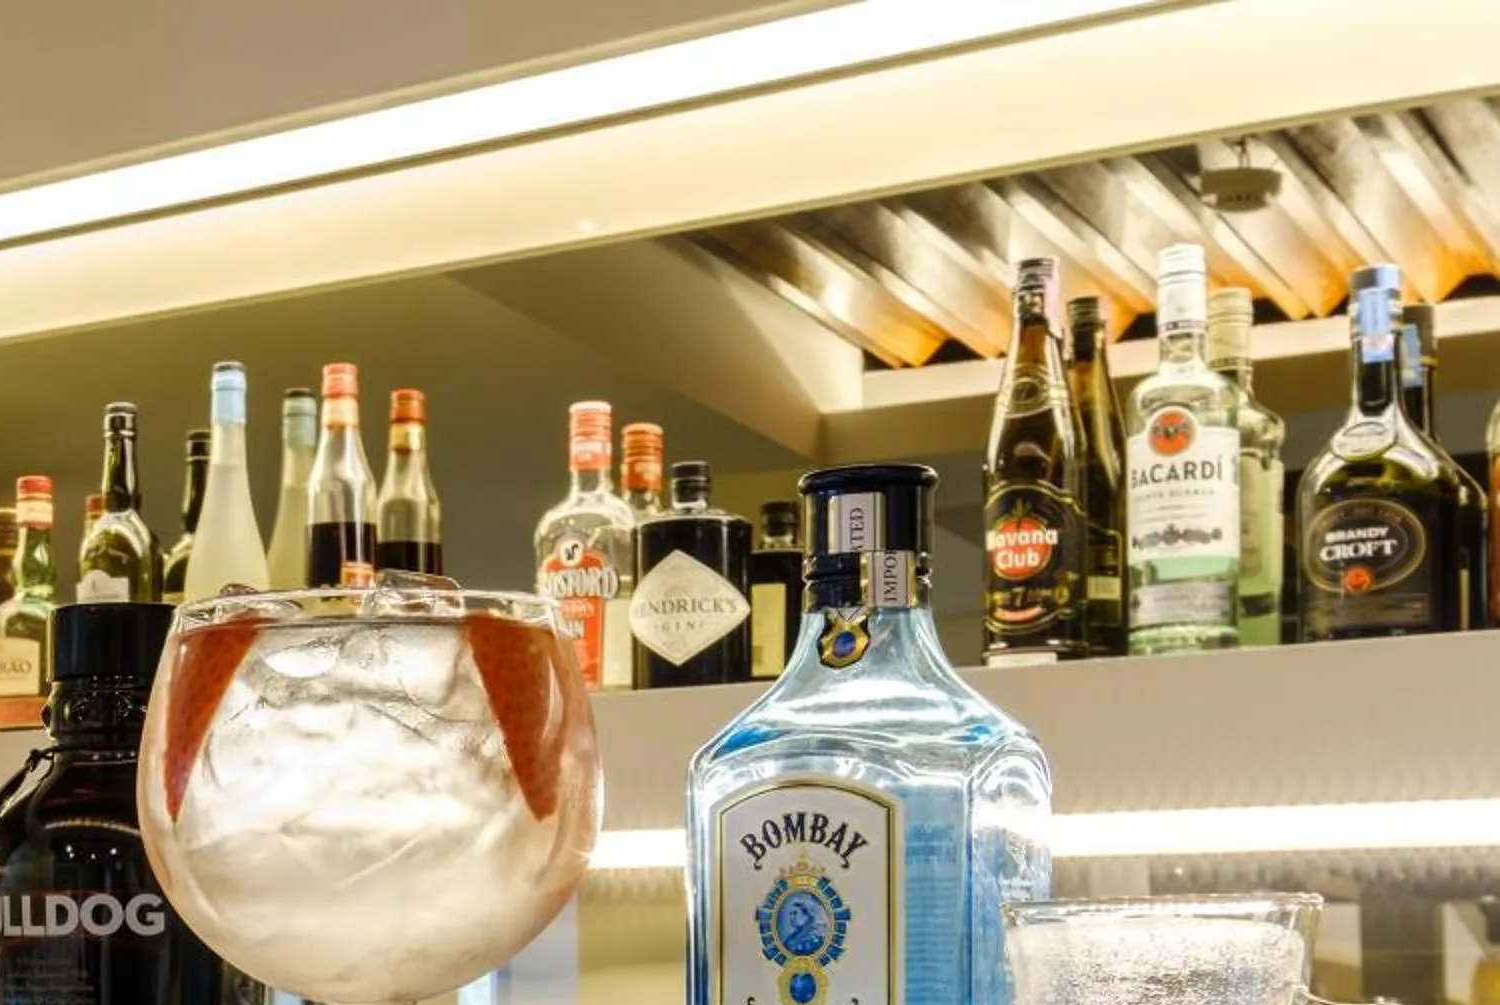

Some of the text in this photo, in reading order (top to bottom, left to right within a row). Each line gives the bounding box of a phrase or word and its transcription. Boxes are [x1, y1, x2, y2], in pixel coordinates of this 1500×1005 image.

[995, 547, 1041, 569] Club
[1319, 539, 1399, 562] CROFT
[635, 597, 738, 617] ENDRICK'S
[740, 811, 869, 871] BOMBAY
